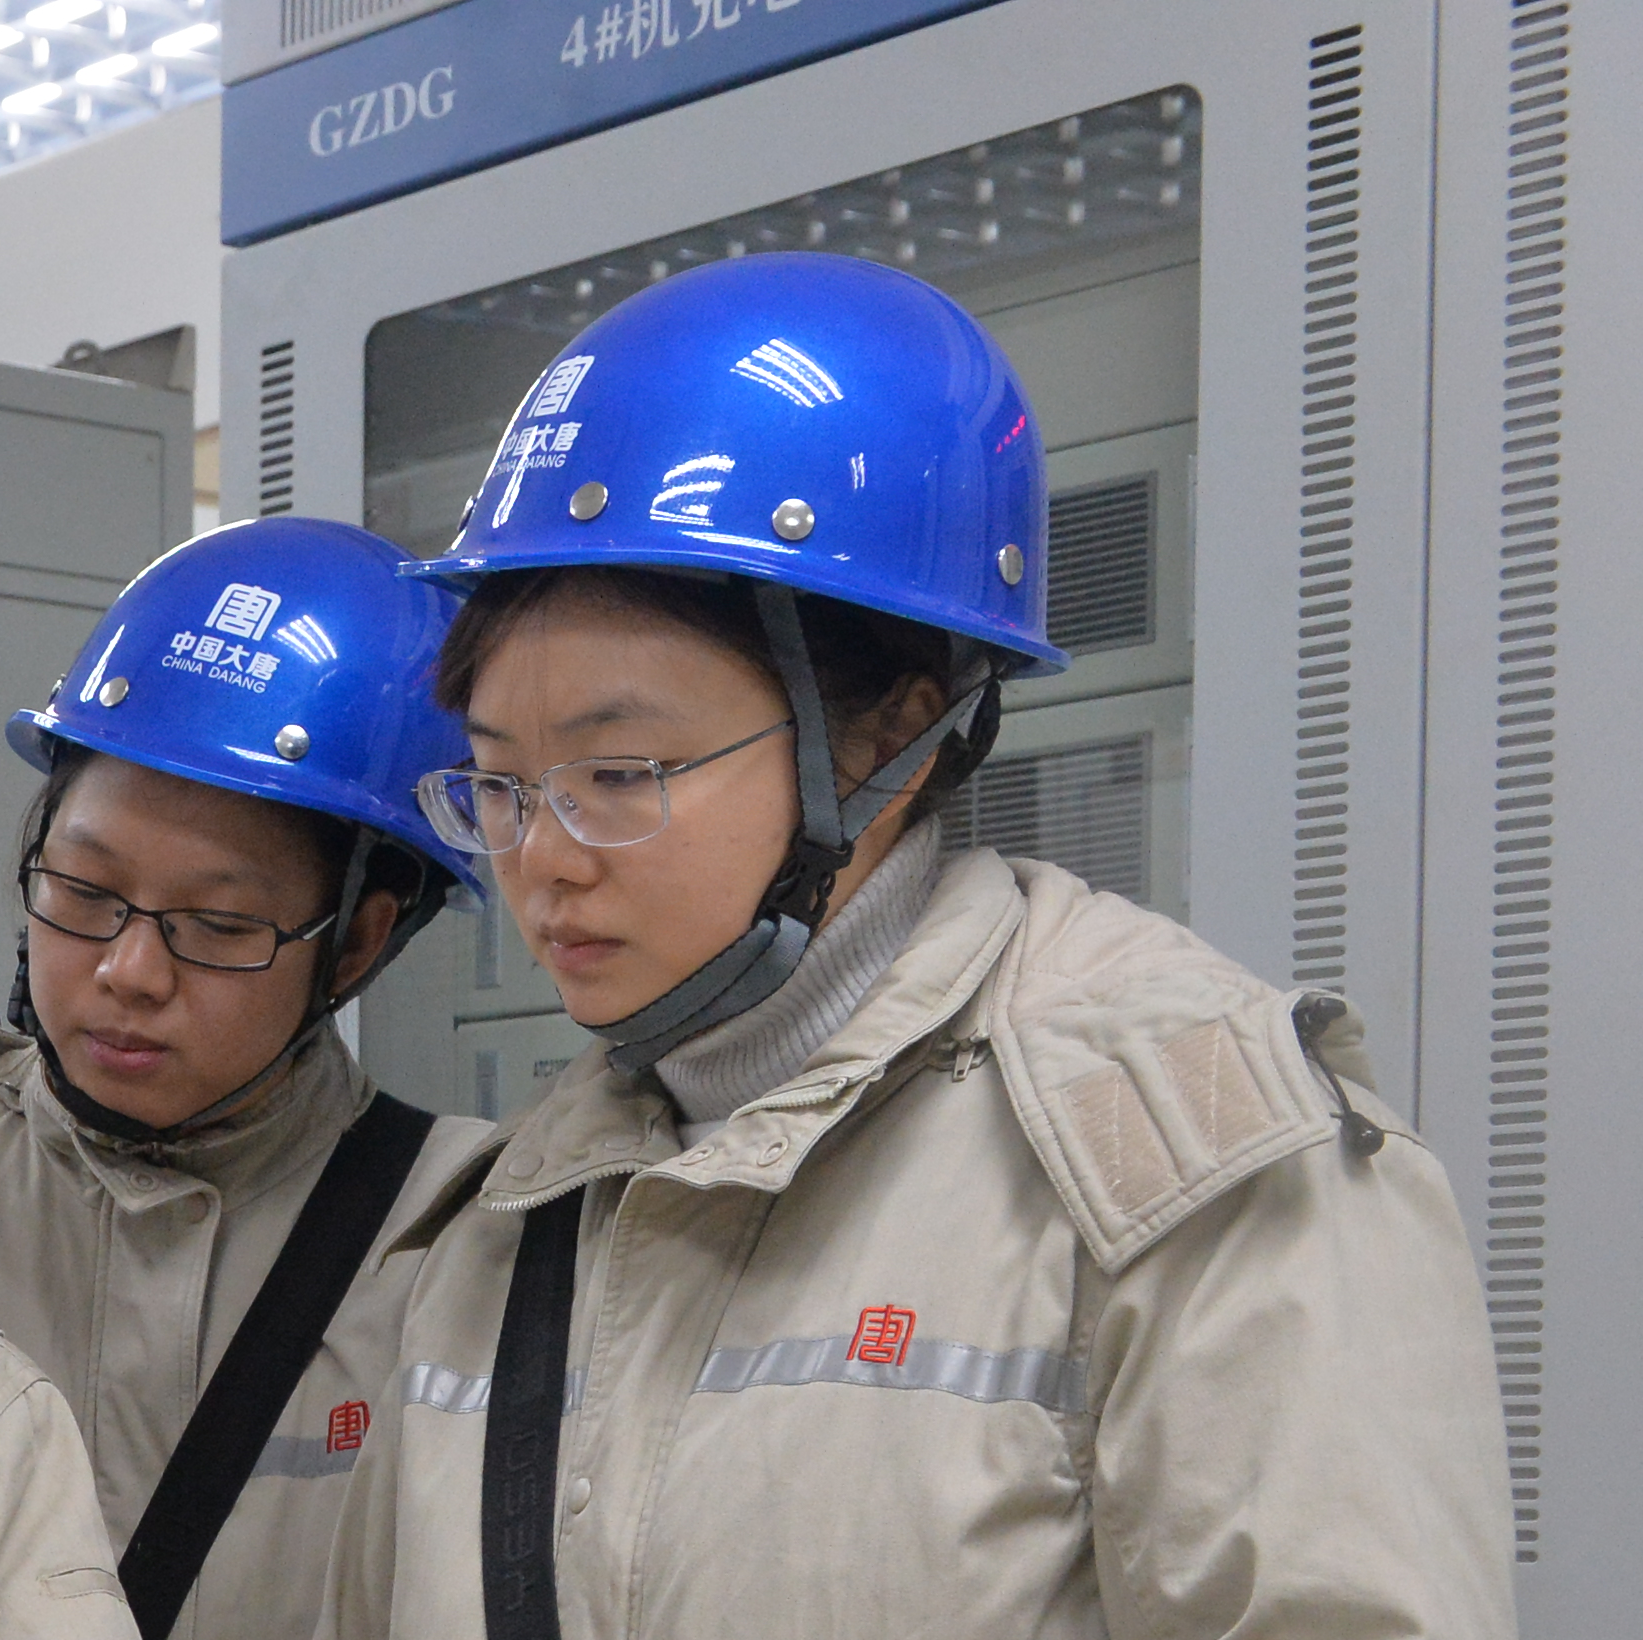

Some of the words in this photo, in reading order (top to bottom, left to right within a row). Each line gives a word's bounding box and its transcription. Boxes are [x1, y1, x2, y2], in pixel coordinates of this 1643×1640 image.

[308, 64, 458, 157] GZDG
[502, 422, 582, 460] 中国大唐
[161, 655, 203, 675] CHINA
[208, 666, 267, 694] DATANG
[170, 630, 281, 681] 中国大唐
